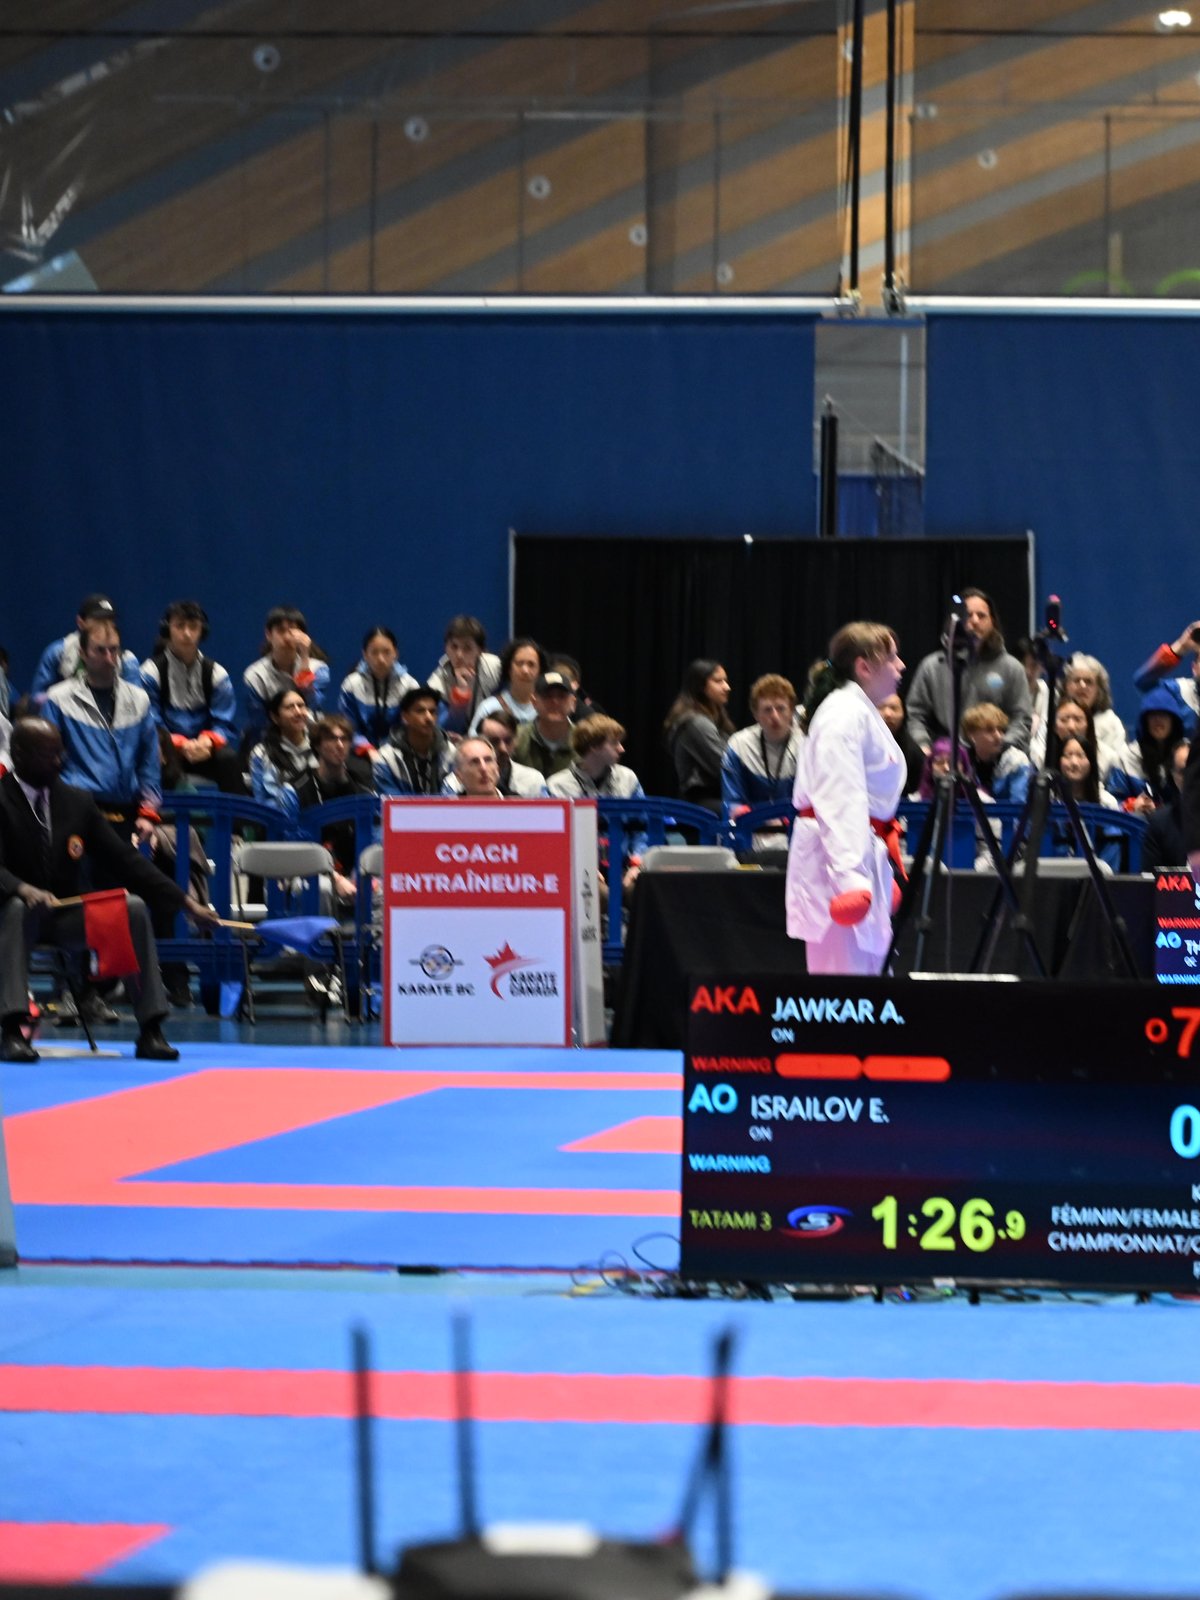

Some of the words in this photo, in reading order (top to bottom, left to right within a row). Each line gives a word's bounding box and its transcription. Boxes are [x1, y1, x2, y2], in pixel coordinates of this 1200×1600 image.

[435, 843, 518, 864] COACH
[1157, 875, 1192, 891] AKA
[1156, 931, 1182, 949] AO
[398, 983, 454, 997] KARATE
[456, 983, 476, 997] BC
[690, 985, 761, 1015] AKA
[771, 997, 876, 1024] JAWKAR
[879, 998, 905, 1025] A.
[771, 1027, 795, 1044] ON
[691, 1056, 772, 1074] WARNING
[688, 1083, 738, 1114] AO
[750, 1094, 864, 1123] ISRAILOV
[869, 1097, 890, 1124] E.
[749, 1125, 773, 1142] ON
[688, 1154, 772, 1174] WARNING
[688, 1209, 757, 1231] TATAMI
[759, 1210, 773, 1232] 3
